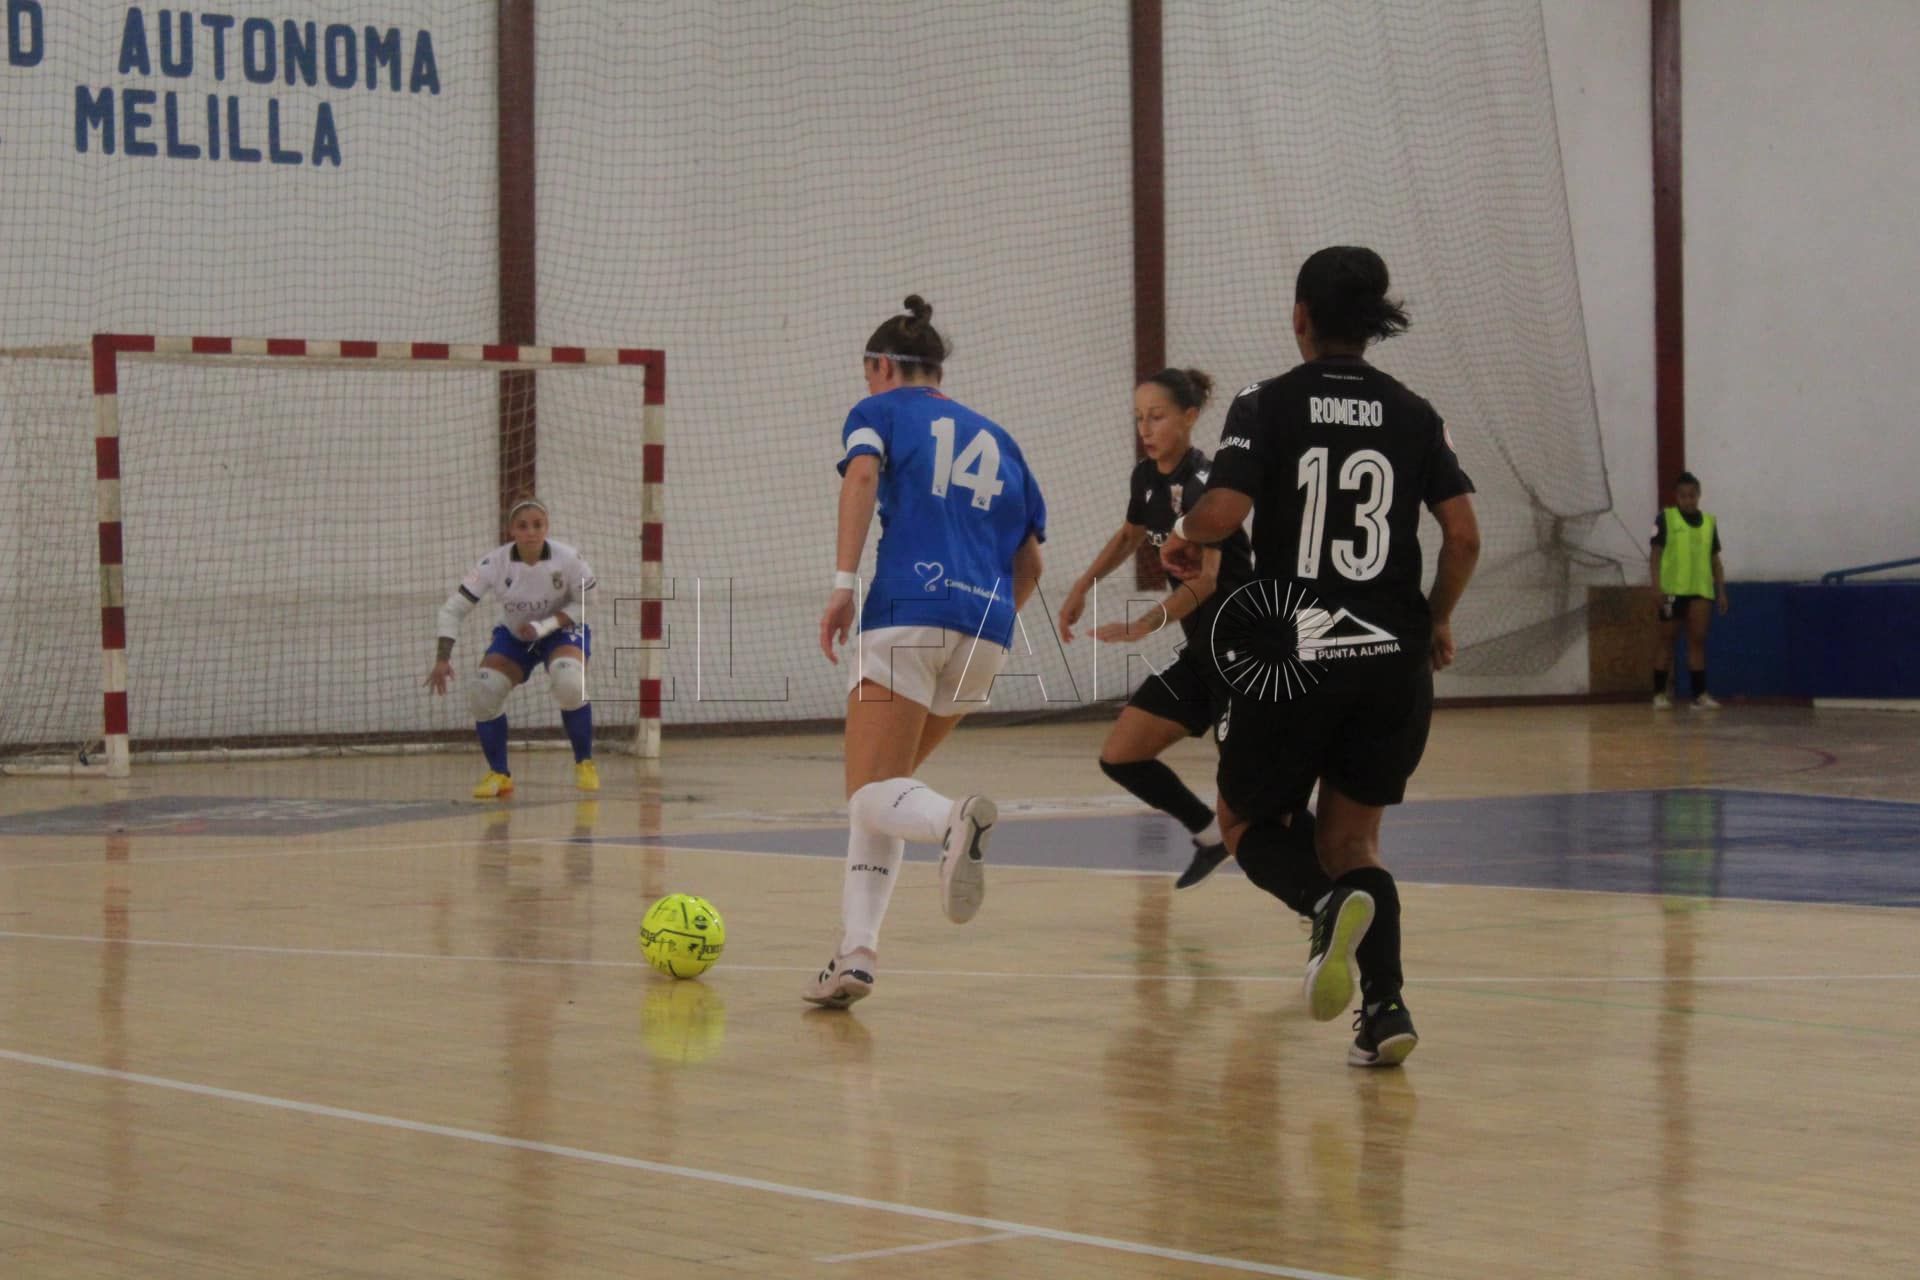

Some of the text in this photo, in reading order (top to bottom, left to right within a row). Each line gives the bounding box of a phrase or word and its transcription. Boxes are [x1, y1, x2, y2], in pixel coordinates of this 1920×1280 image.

[8, 0, 440, 95] D AUTONOMA
[75, 85, 341, 166] MELILLA
[1310, 397, 1383, 427] ROMERO
[931, 417, 1004, 511] 14
[1297, 447, 1394, 582] 13
[1318, 642, 1401, 660] PUNTA ALMINA
